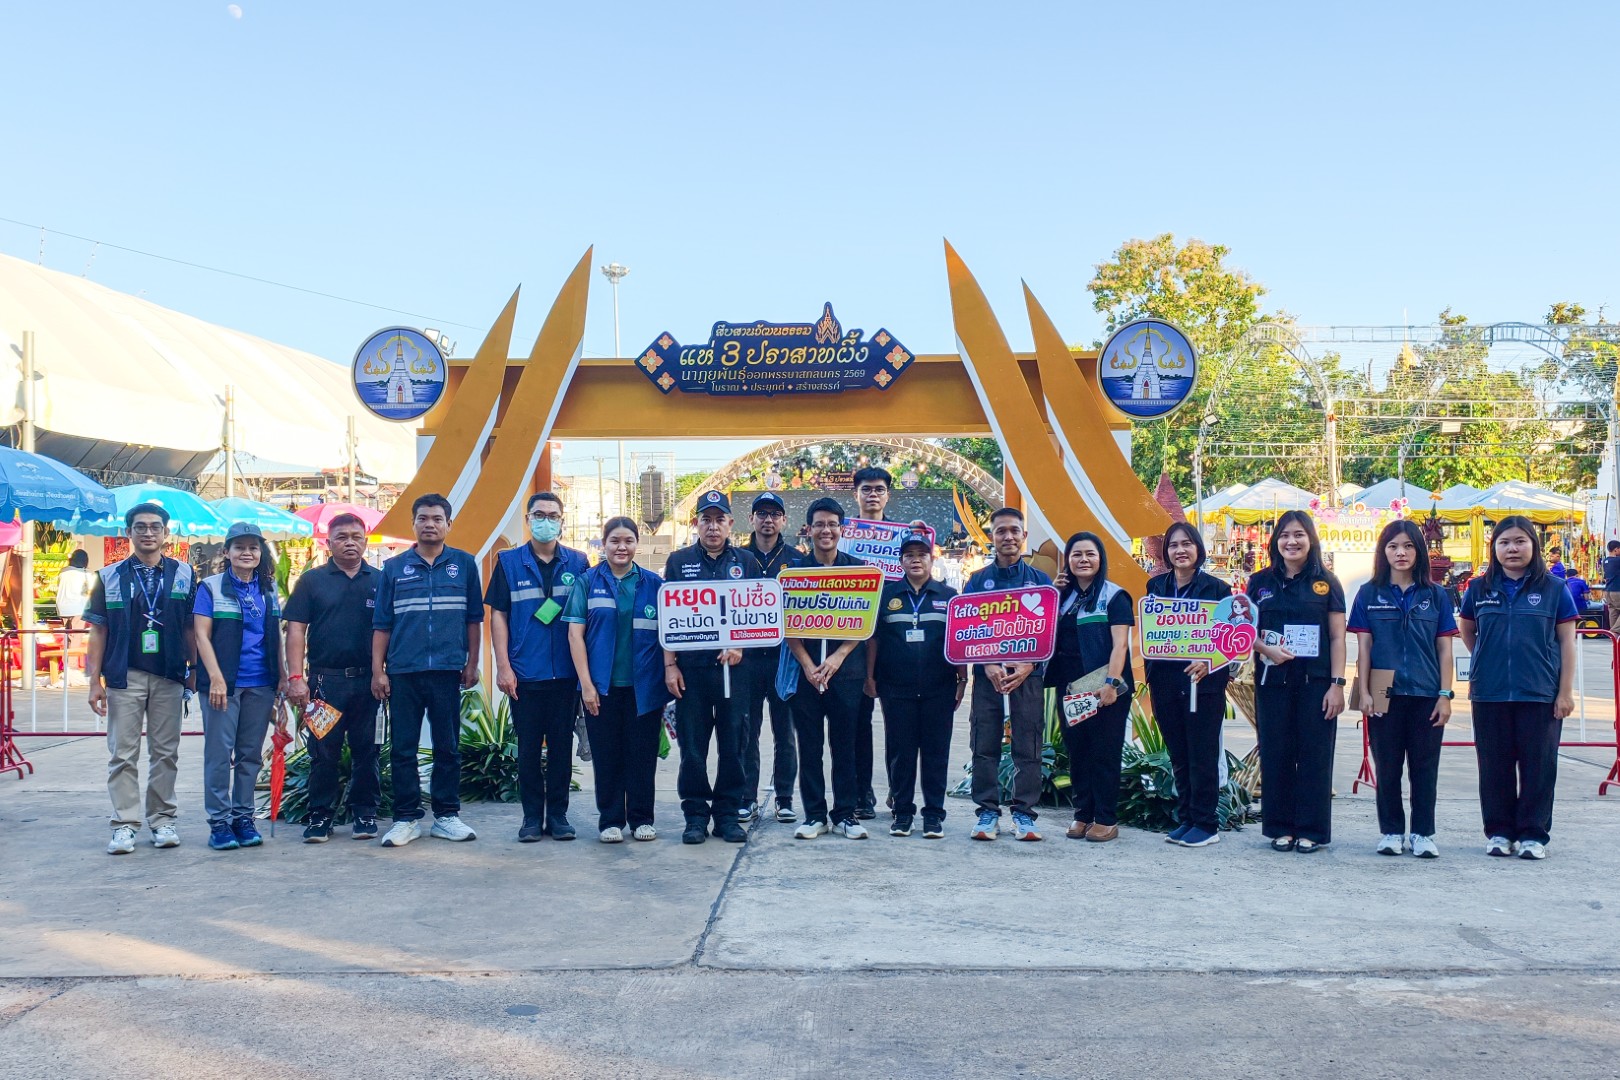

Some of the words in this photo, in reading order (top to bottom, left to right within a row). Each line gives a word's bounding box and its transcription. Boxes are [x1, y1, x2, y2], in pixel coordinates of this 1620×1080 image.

[716, 323, 812, 337] สืบสานวัฒนธรรม
[680, 340, 715, 366] แห่
[721, 341, 741, 366] 3
[747, 331, 869, 365] ปราสาทผึ้ง
[844, 369, 866, 378] 2569
[711, 381, 740, 392] โบราณ
[751, 382, 785, 393] ประยุกต์
[796, 381, 841, 391] สร้างสรรค์
[843, 521, 892, 540] ซื้อง่าย
[665, 588, 717, 613] หยุด
[729, 583, 776, 608] ไม่ซื้อ
[1144, 593, 1200, 614] ซื้อ-ขาย
[669, 614, 714, 629] ละเมิด
[730, 609, 777, 625] ไม่ขาย
[786, 614, 835, 630] 10,000
[837, 616, 863, 629] บาท
[1156, 608, 1208, 626] ของแท้
[1146, 629, 1181, 640] คนขาย
[1191, 628, 1220, 639] สบาย
[1220, 623, 1252, 654] ใจ
[1148, 639, 1178, 654] คนซื้อ
[1187, 643, 1217, 654] สบาย
